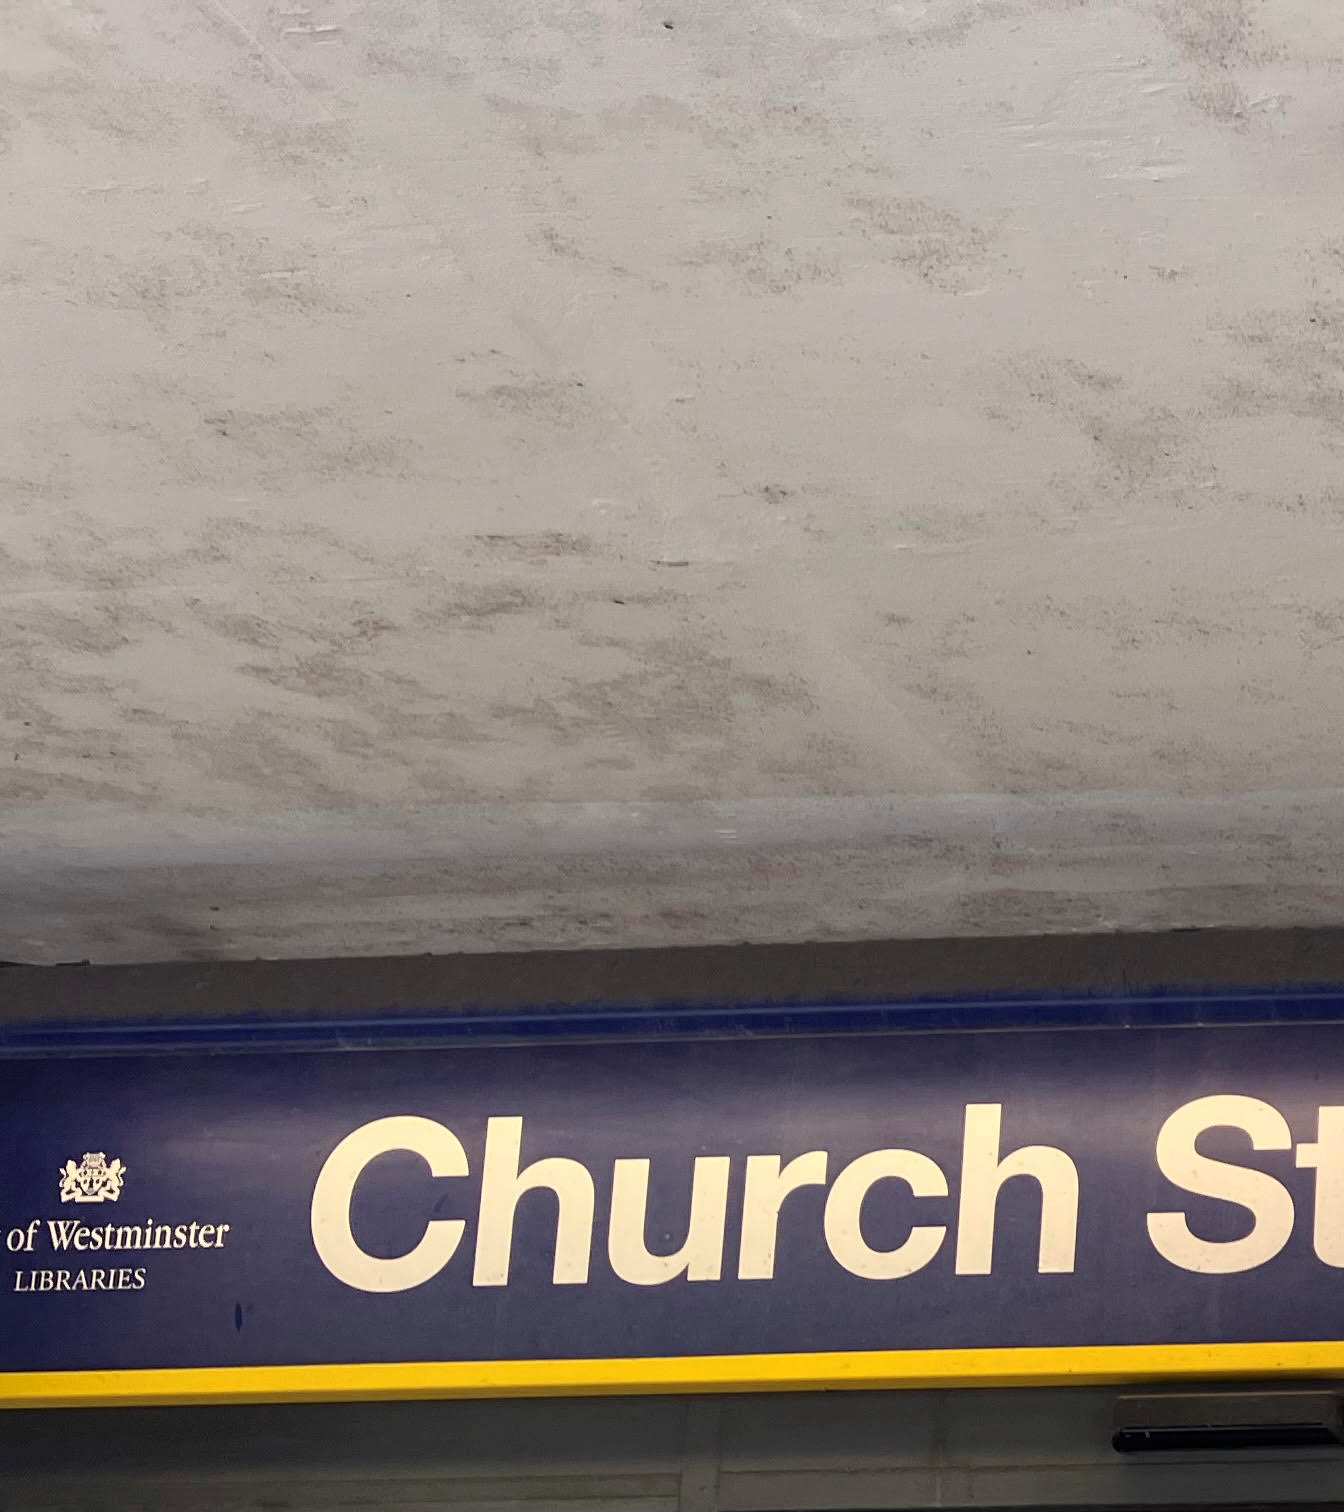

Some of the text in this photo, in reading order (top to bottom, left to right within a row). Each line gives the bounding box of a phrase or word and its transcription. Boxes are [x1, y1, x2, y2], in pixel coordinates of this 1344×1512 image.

[310, 1103, 1081, 1293] Church
[6, 1219, 40, 1252] of
[47, 1218, 231, 1251] Westminster
[14, 1268, 147, 1291] LIBRARIES
